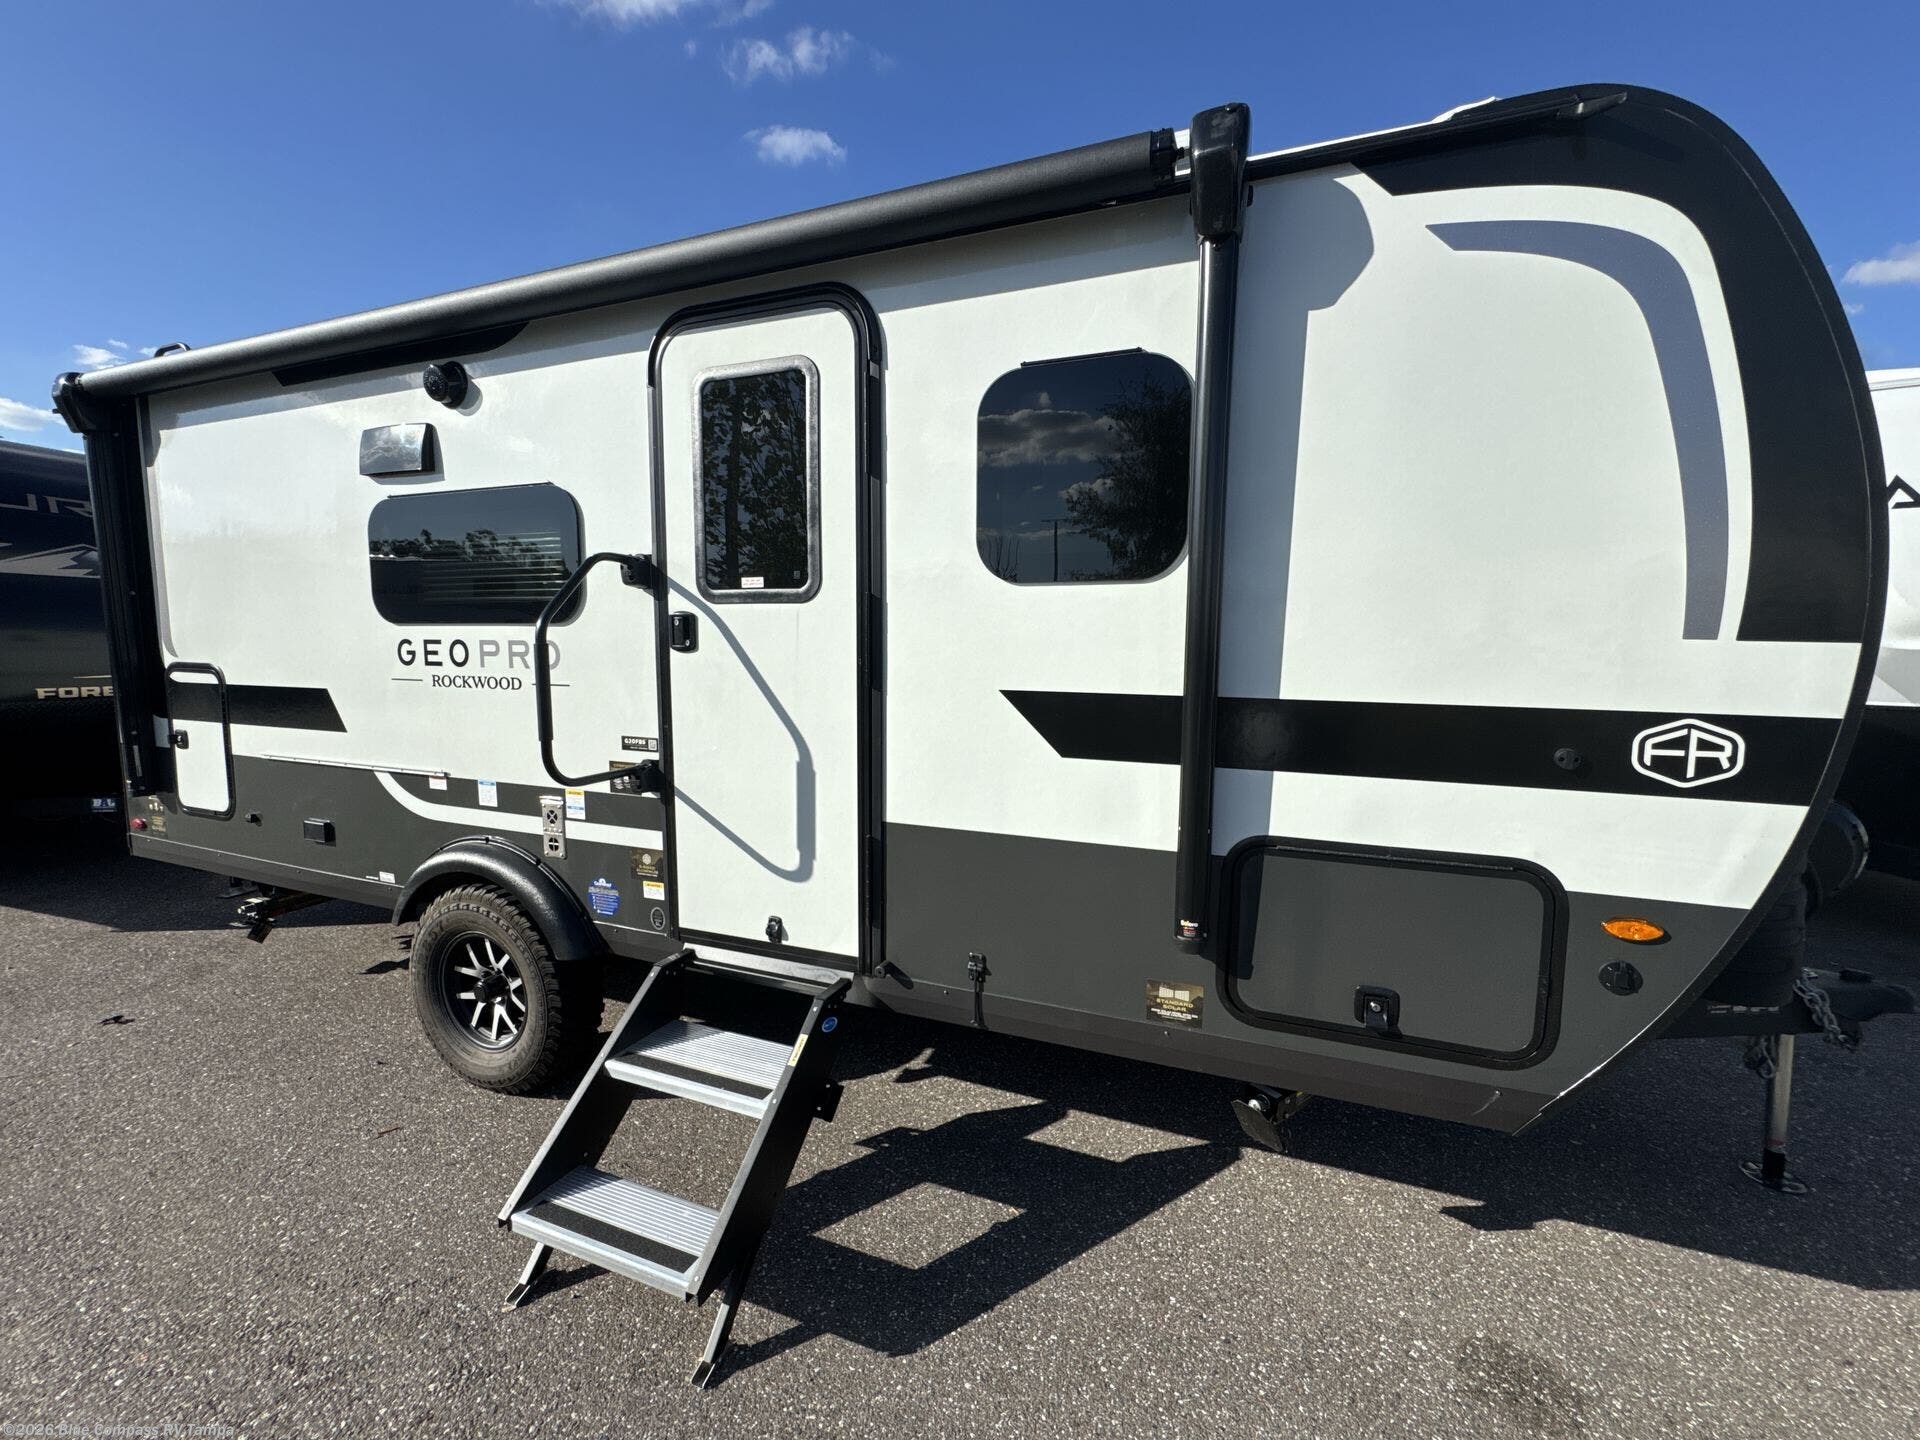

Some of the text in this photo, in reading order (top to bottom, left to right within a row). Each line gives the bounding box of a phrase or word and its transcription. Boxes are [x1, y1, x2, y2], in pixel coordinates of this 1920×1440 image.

[431, 674, 522, 690] ROCKWOOD
[1156, 998, 1194, 1008] STANDARD
[1162, 1004, 1187, 1012] SOLAR
